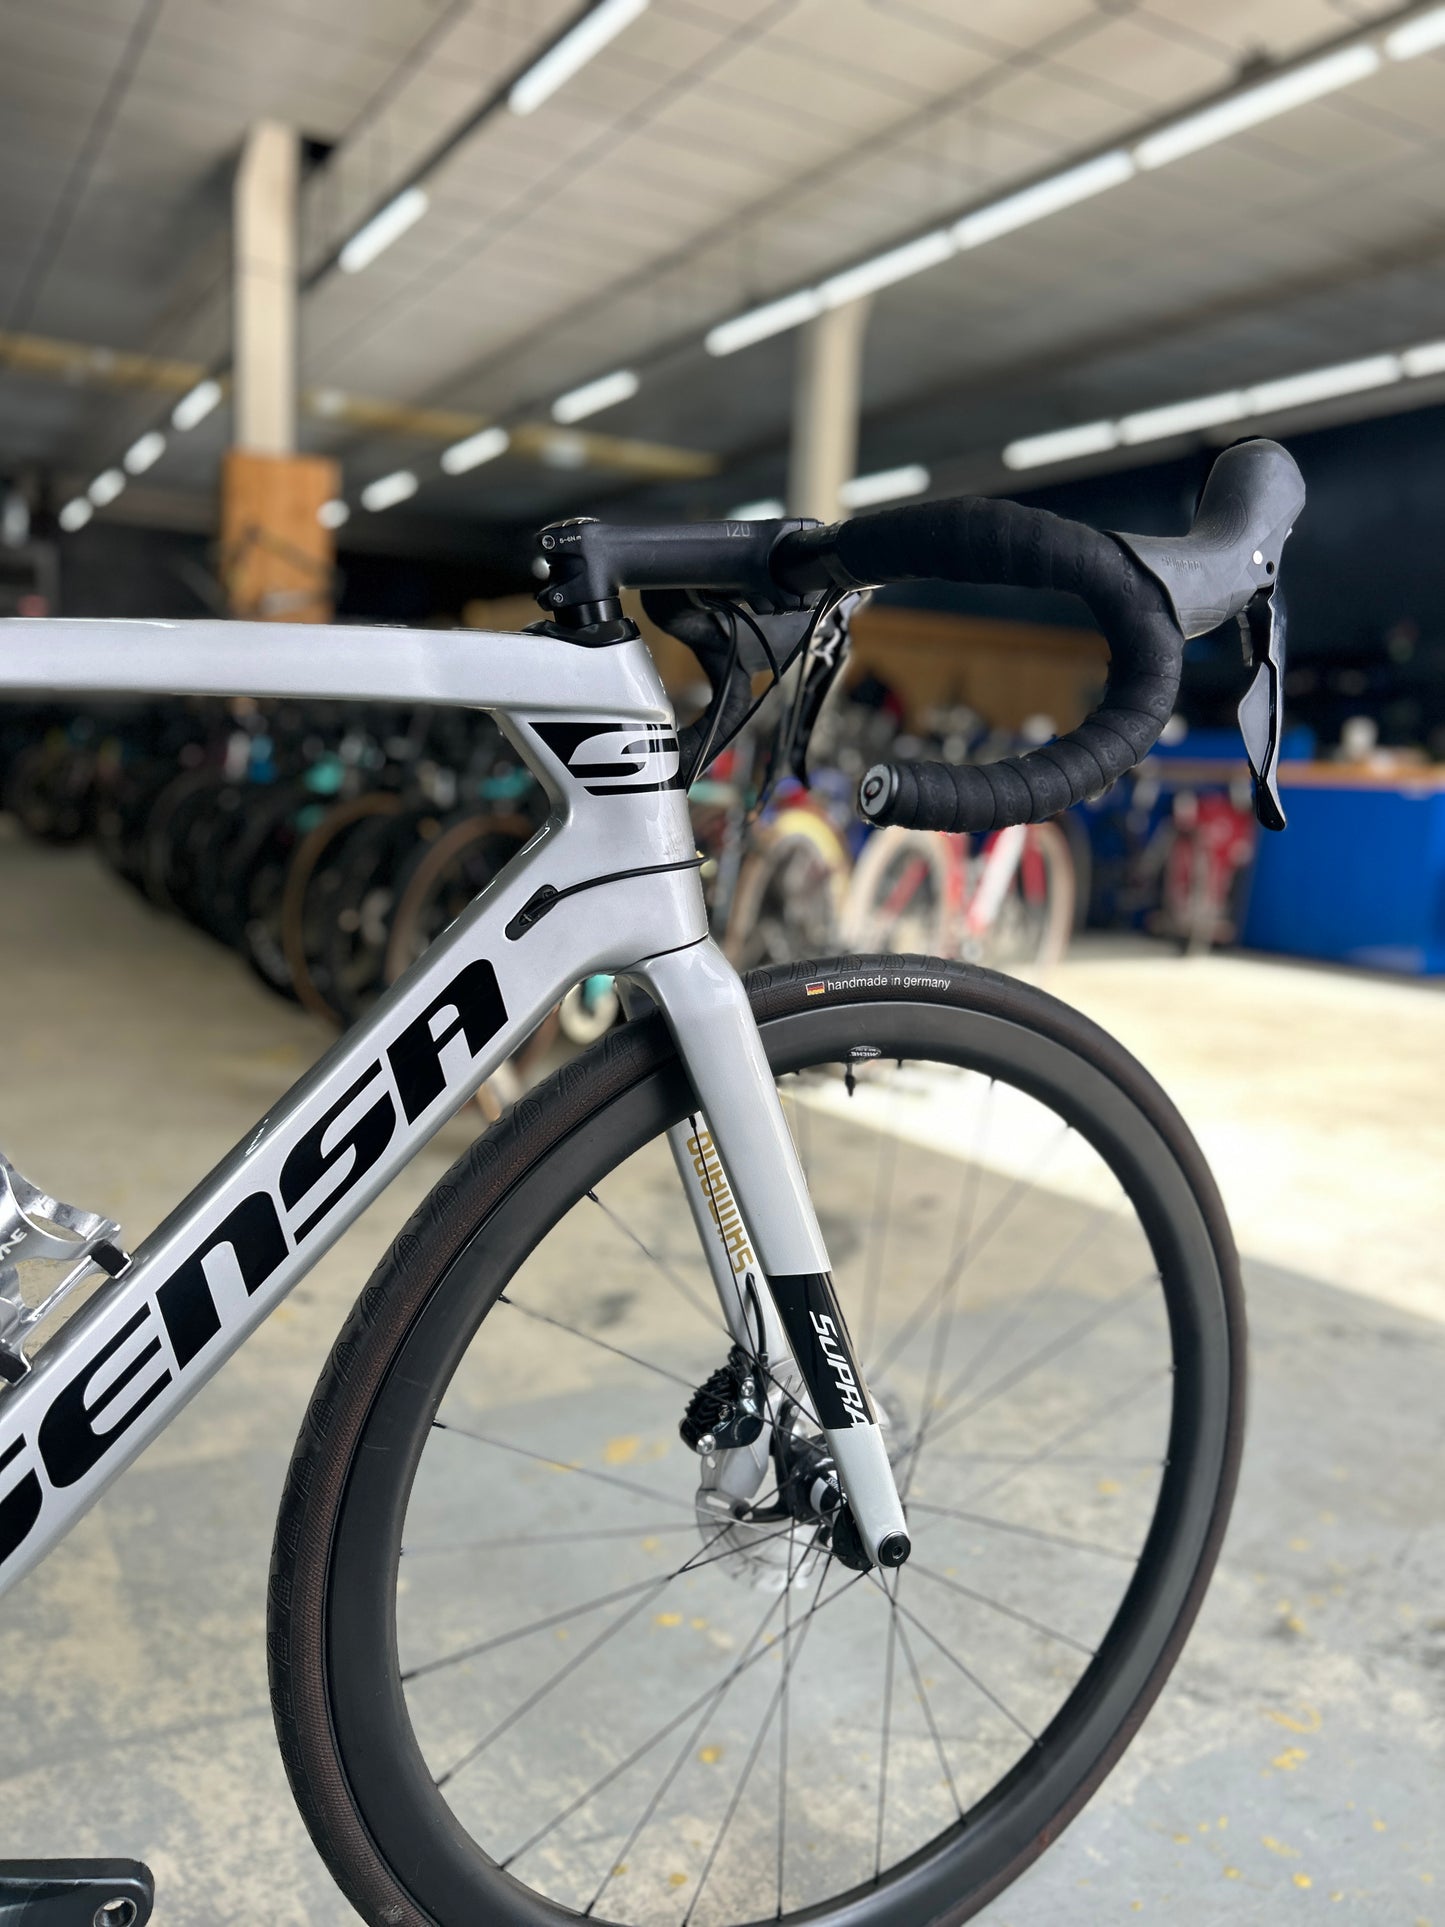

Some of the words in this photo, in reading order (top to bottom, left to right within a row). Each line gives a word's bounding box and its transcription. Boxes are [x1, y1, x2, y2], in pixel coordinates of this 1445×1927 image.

[827, 975, 888, 991] handmade
[890, 975, 901, 986] in
[903, 975, 951, 991] germany
[686, 1131, 754, 1274] SHIMANO
[809, 1310, 871, 1428] SUPRA
